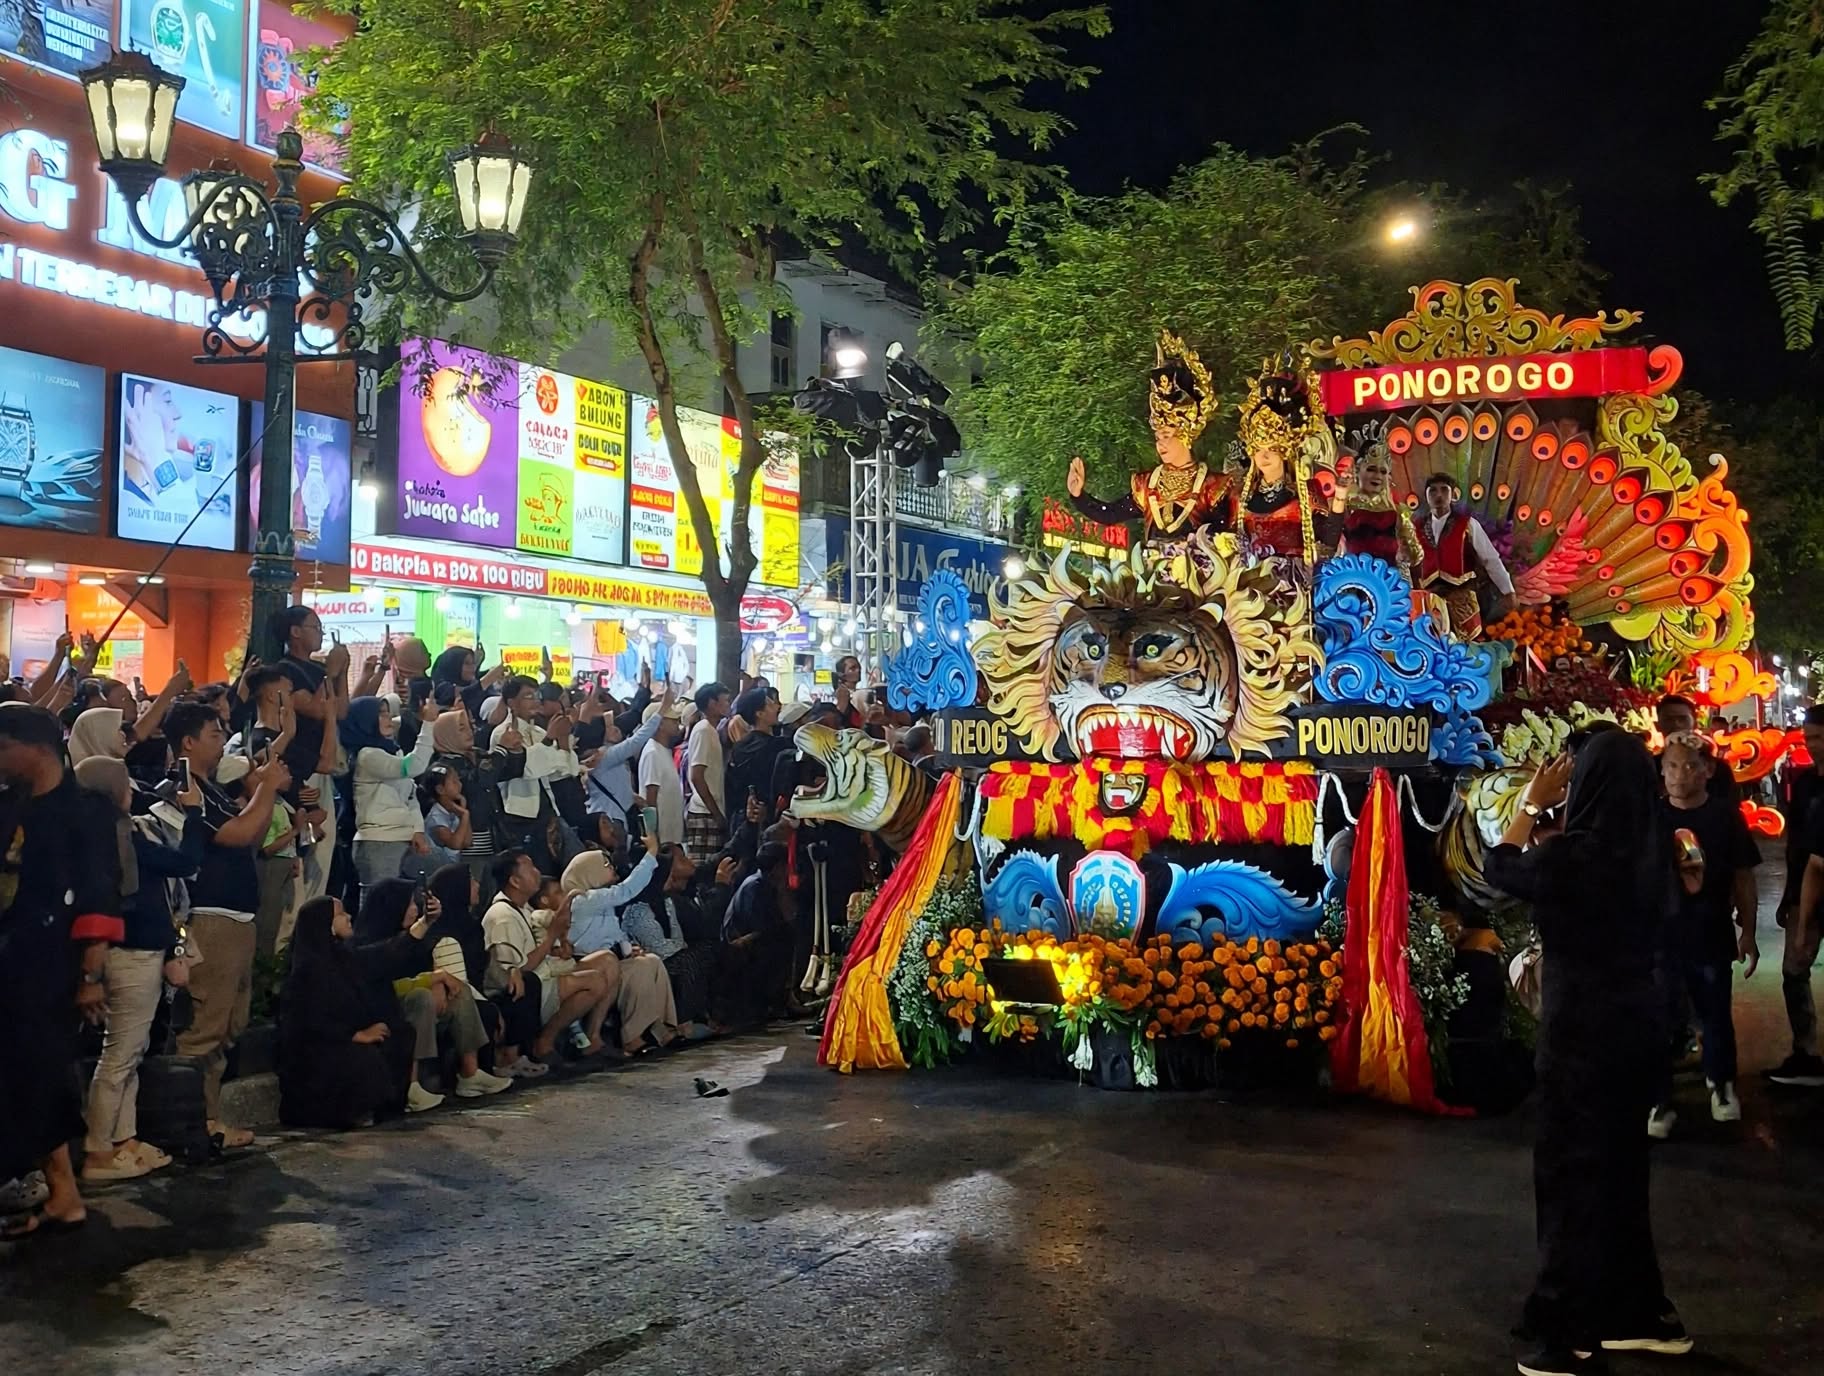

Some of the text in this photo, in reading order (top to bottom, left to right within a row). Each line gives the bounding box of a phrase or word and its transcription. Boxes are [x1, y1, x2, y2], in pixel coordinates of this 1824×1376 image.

[1353, 362, 1574, 406] PONOROGO
[433, 562, 447, 579] 12
[450, 561, 479, 582] BOX
[482, 565, 508, 585] 100
[511, 569, 545, 591] RIBU
[951, 719, 1008, 755] REOG
[1298, 715, 1430, 756] PONOROGO
